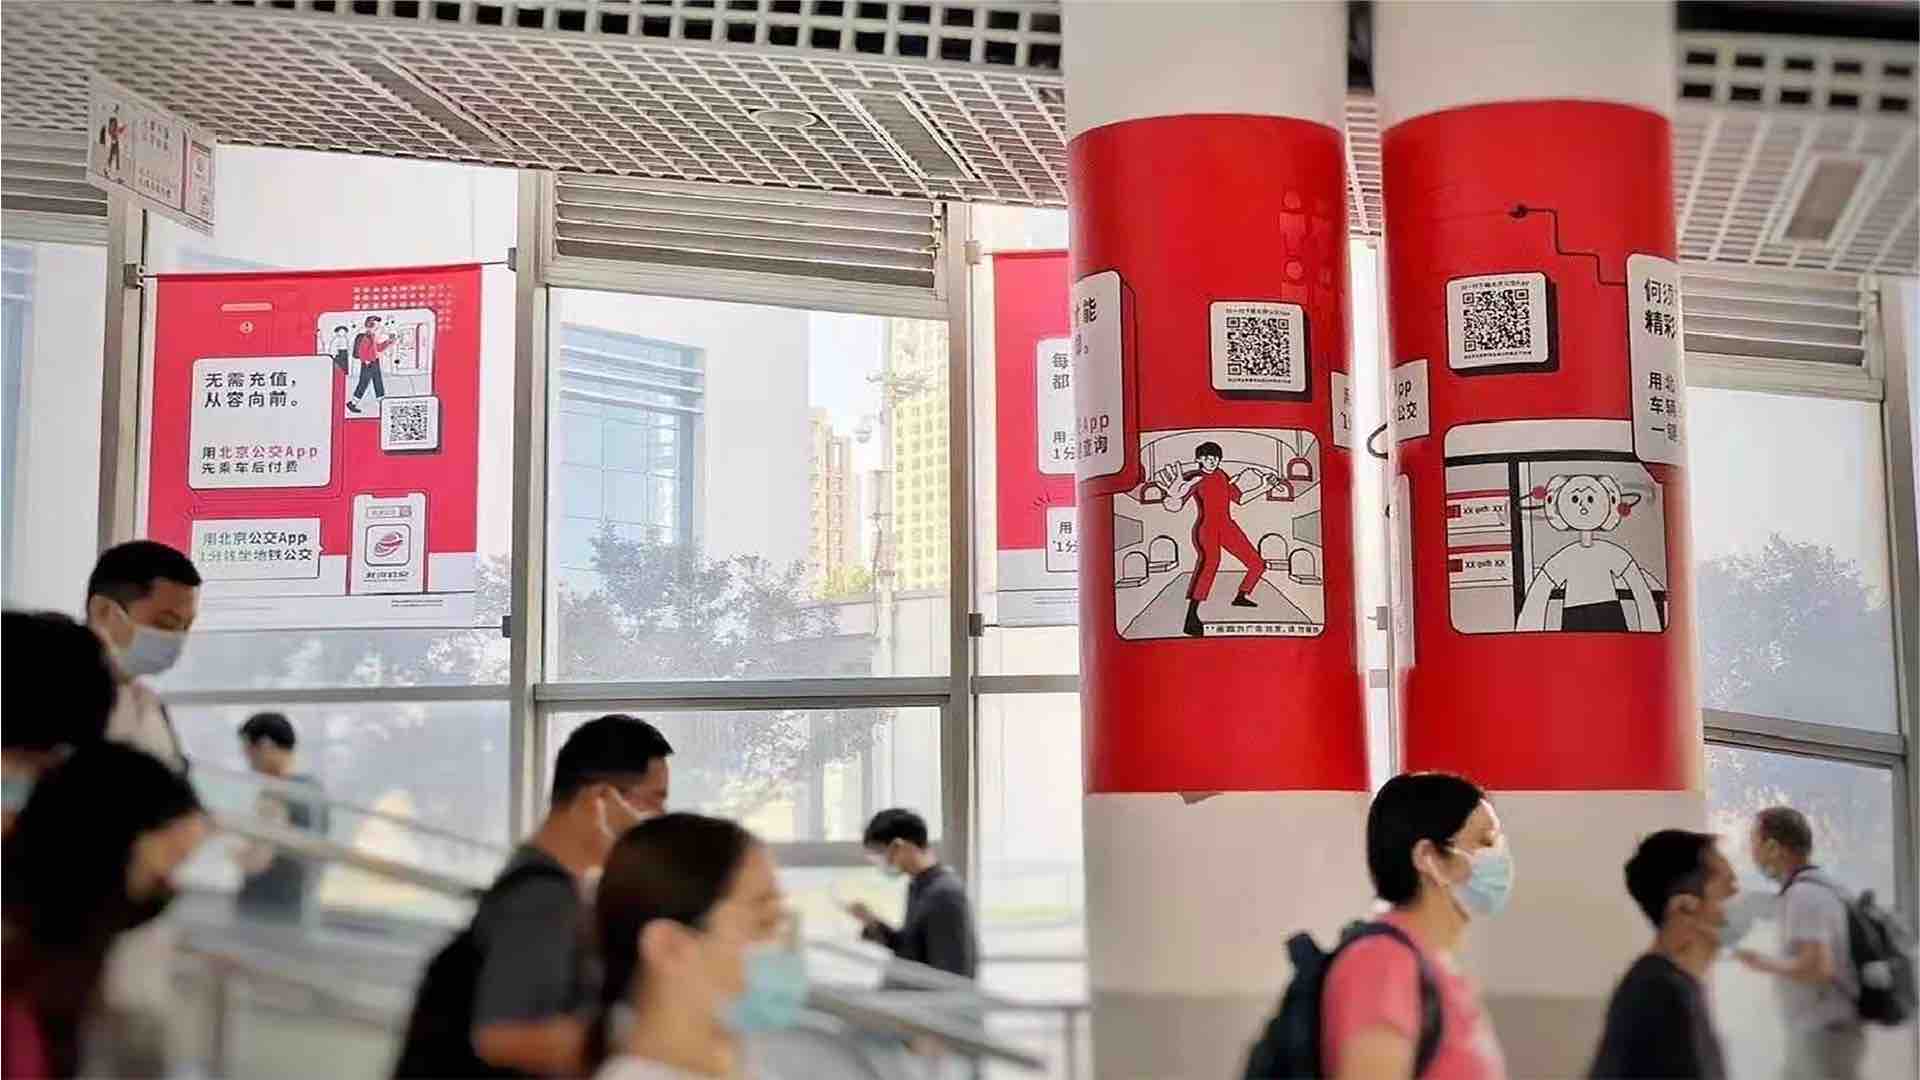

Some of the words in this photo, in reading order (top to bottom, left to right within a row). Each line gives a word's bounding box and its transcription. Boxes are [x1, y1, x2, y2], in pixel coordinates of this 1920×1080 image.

[1053, 352, 1069, 370] 每
[1053, 373, 1070, 390] 都
[204, 390, 299, 409] 从容向前。
[202, 446, 319, 461] 用北京公交App
[201, 461, 298, 474] 先乘车后付费
[1060, 521, 1073, 535] 用
[202, 531, 308, 546] 用北京公交App
